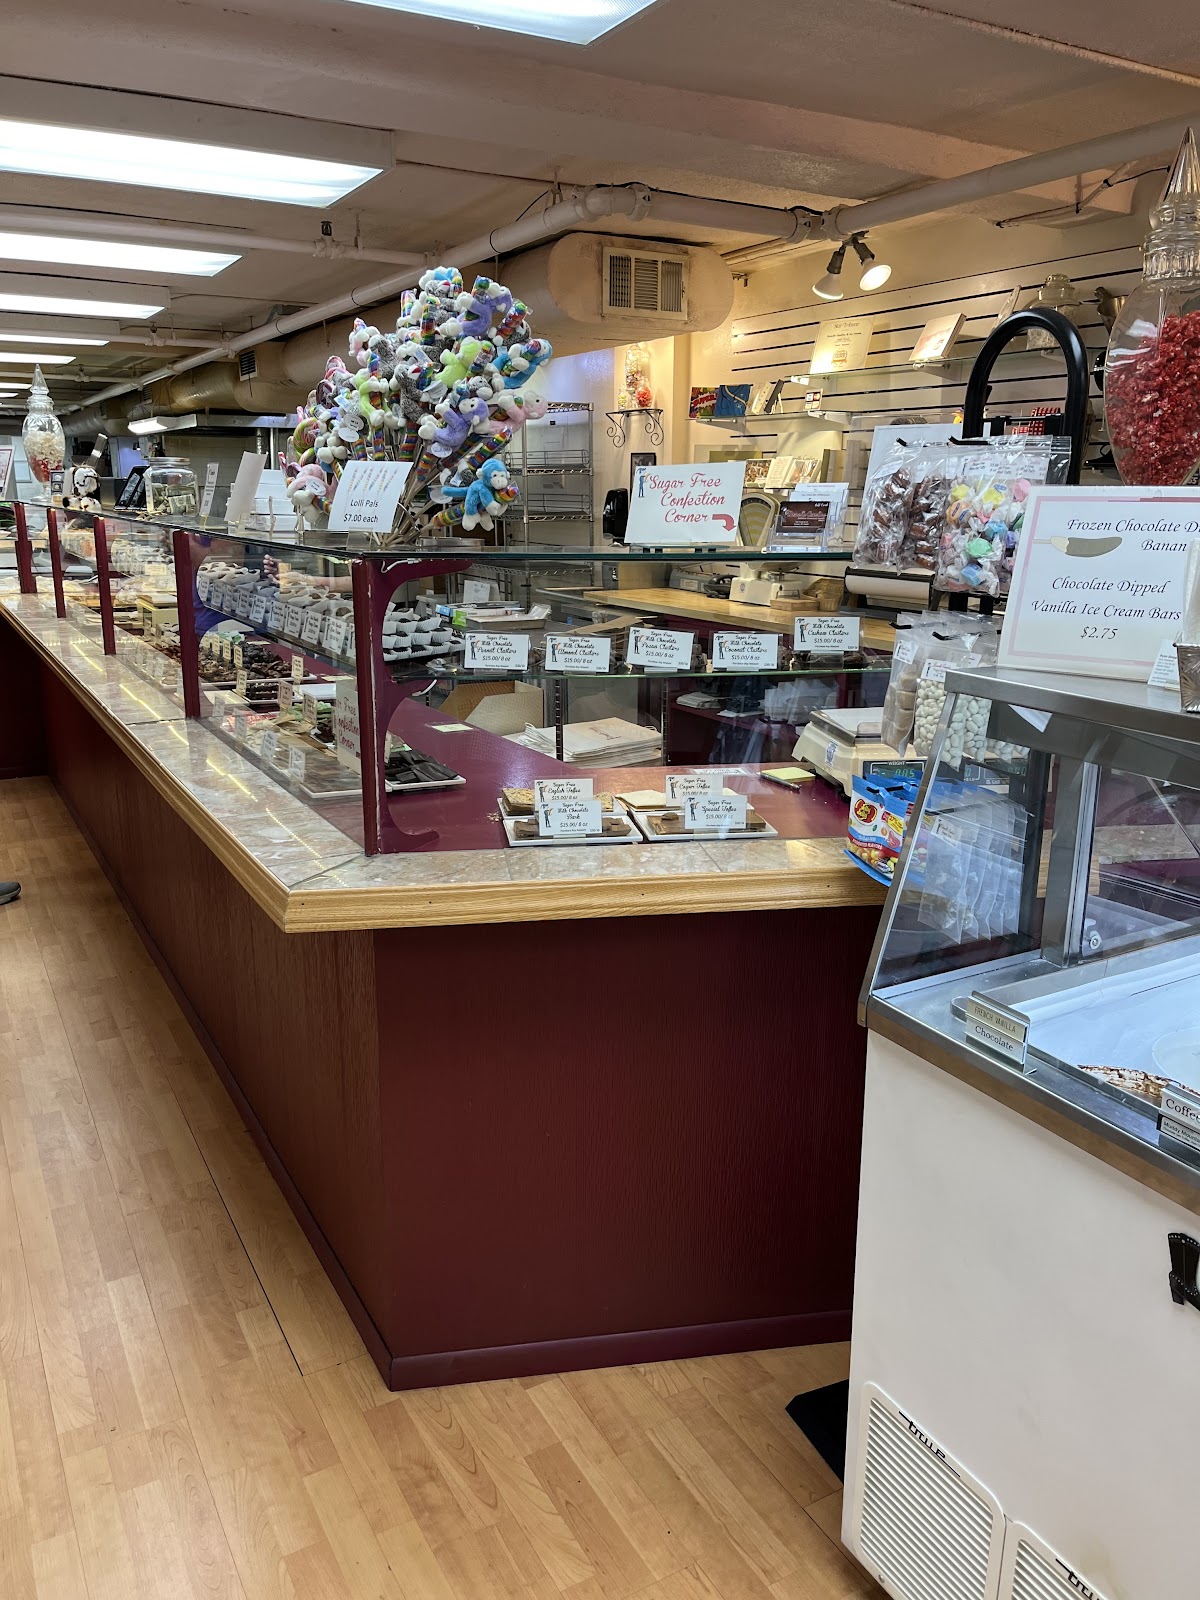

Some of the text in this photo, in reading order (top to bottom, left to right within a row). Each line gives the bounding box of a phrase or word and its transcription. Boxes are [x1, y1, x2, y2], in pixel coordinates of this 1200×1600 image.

[649, 472, 722, 494] Sugar Free
[660, 490, 725, 509] Confection
[344, 514, 378, 523] $7.00 each
[664, 508, 708, 523] Corner
[1067, 519, 1112, 531] Frozen
[1115, 518, 1181, 533] Chocolate
[1052, 576, 1170, 596] Chocolate Dipped
[1031, 600, 1182, 621] Vanilla Ice Cream Bars
[1080, 626, 1118, 640] $2.75
[974, 1006, 1016, 1033] FRENCH VANILLA
[975, 1026, 1014, 1051] Chocolate
